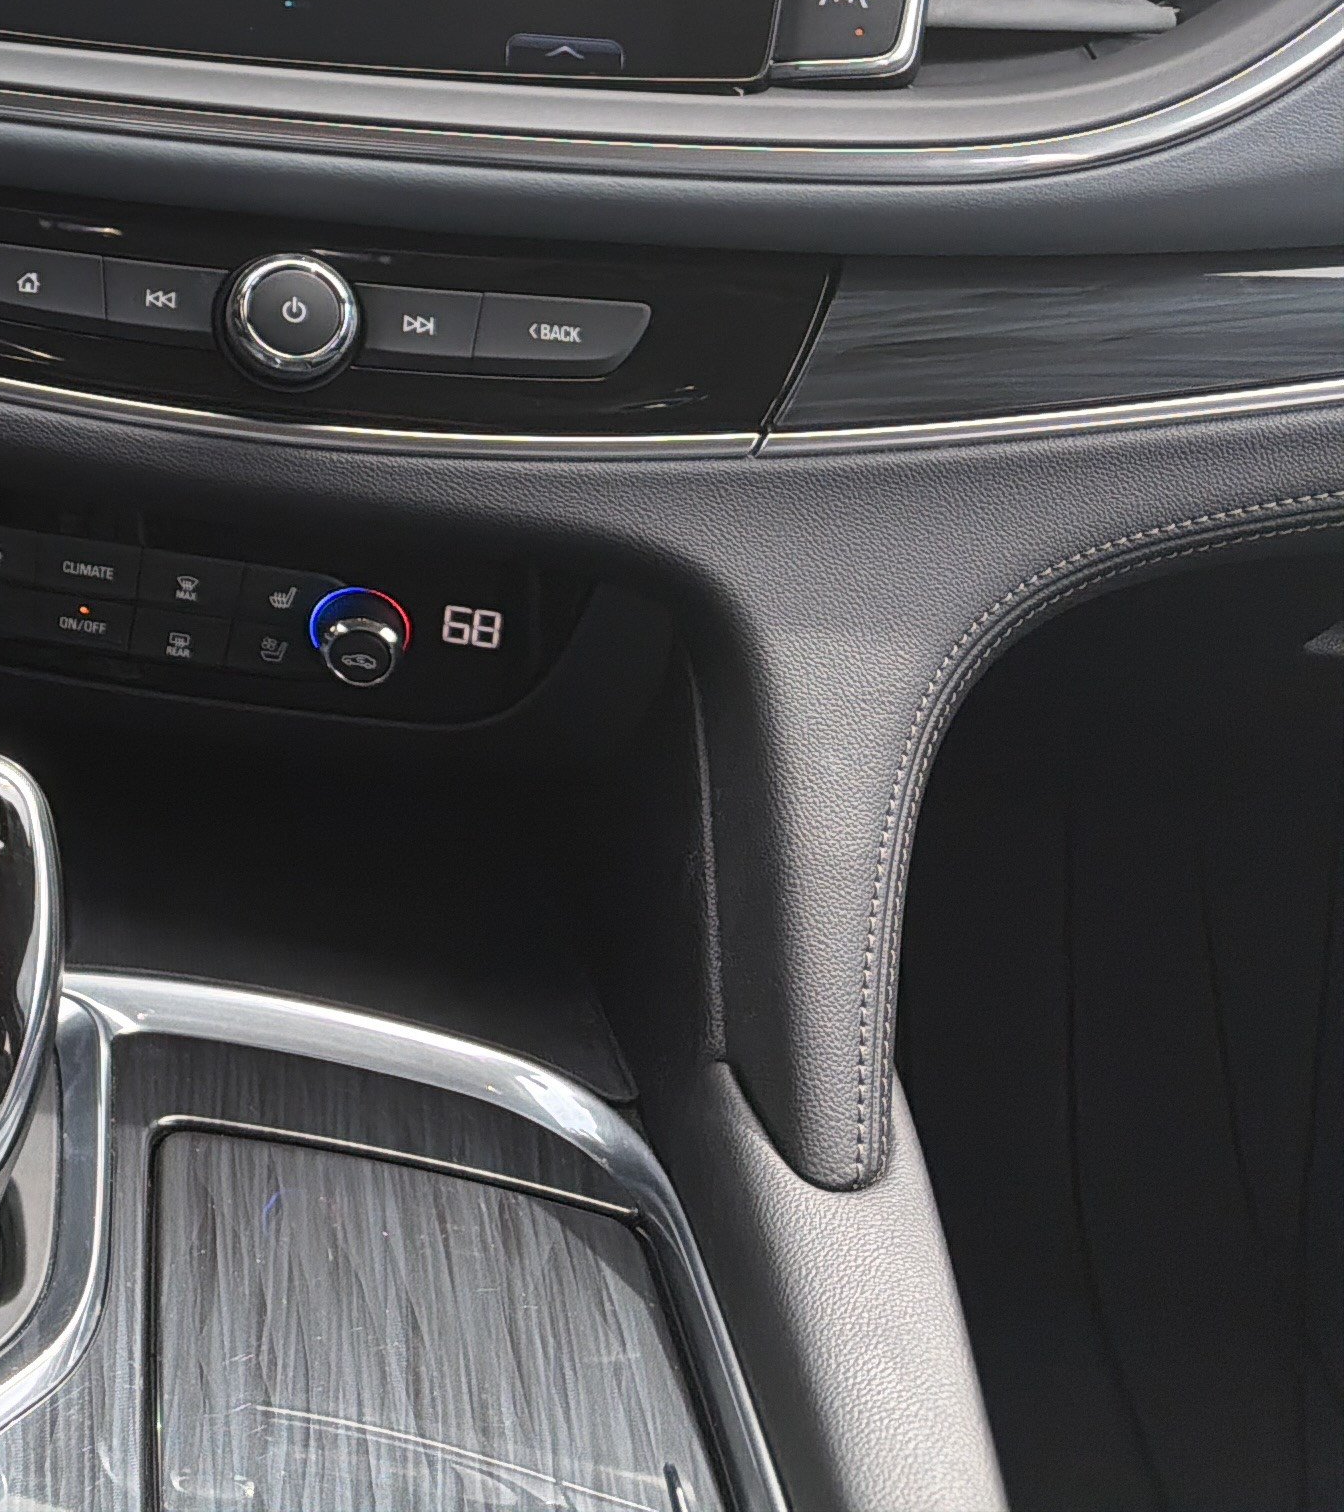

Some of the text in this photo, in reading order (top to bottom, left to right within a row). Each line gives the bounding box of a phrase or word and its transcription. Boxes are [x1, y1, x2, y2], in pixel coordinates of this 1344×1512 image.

[540, 323, 582, 343] BACK
[62, 560, 115, 581] CLIMATE
[175, 589, 198, 602] MAX
[59, 616, 107, 635] ON/OFF
[442, 604, 502, 649] 68
[165, 645, 191, 659] REAR
